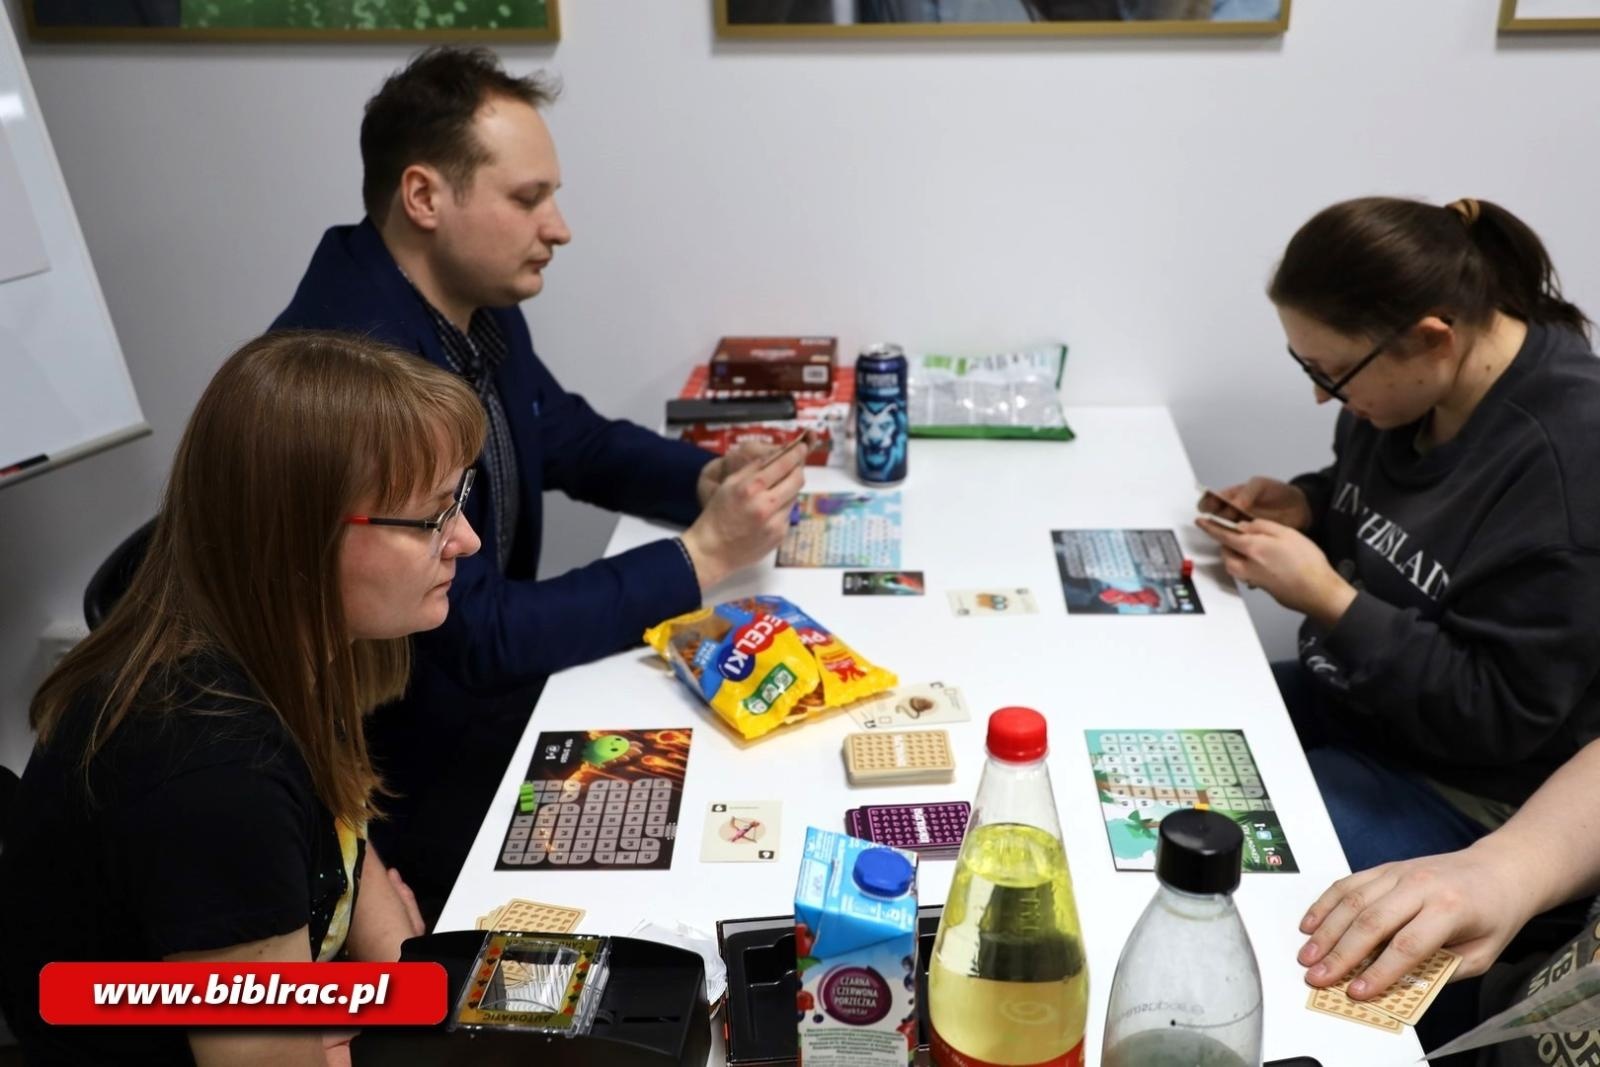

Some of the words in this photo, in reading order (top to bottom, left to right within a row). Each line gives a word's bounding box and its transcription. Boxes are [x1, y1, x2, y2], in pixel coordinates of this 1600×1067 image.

[840, 976, 871, 987] CZARNA
[836, 986, 878, 998] CZERWONA
[833, 996, 877, 1008] PORZECZKA
[483, 1013, 553, 1023] AUTOMATIC
